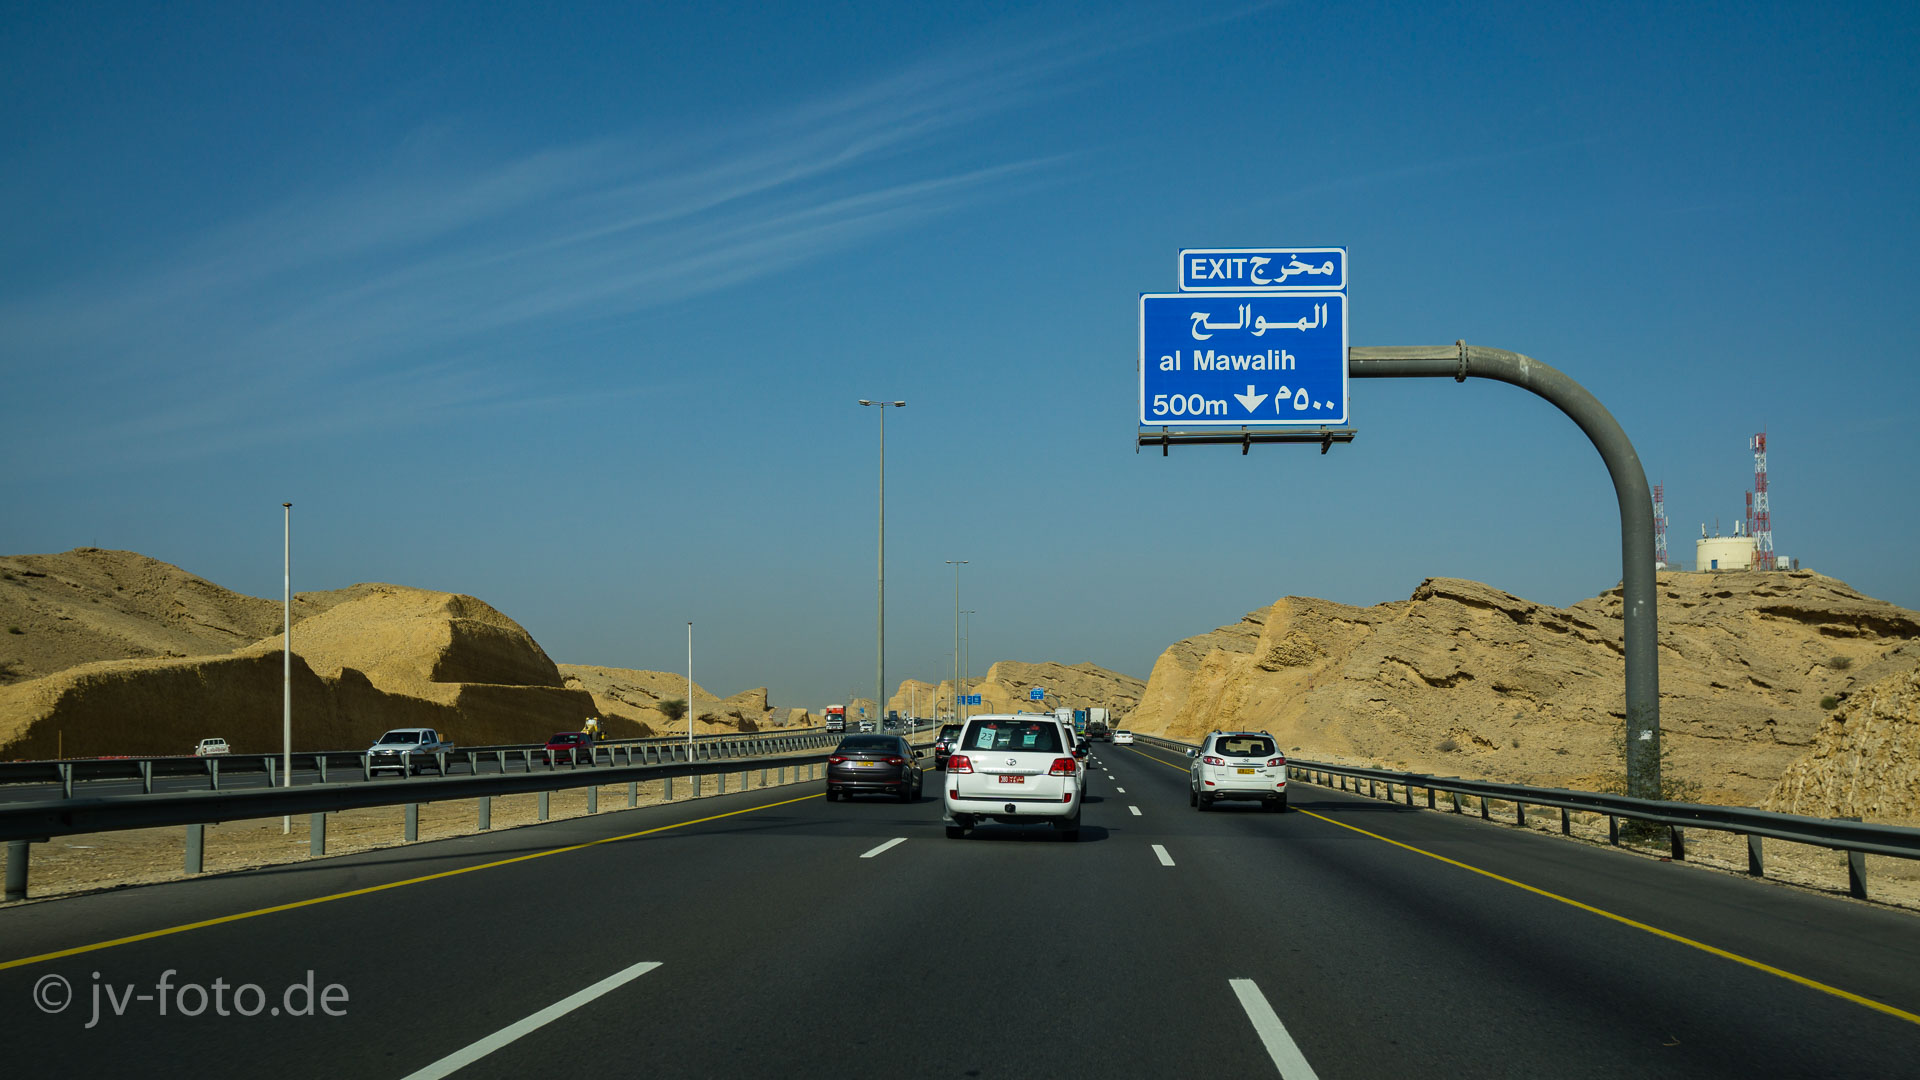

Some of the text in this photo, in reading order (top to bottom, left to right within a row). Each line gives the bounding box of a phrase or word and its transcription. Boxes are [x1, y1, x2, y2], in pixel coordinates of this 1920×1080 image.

[1191, 258, 1248, 280] EXIT
[1249, 254, 1335, 285] مخرج
[1190, 302, 1328, 341] الموالح
[1159, 349, 1296, 371] al Mawalih
[1152, 393, 1228, 416] 500m
[980, 732, 993, 741] 23
